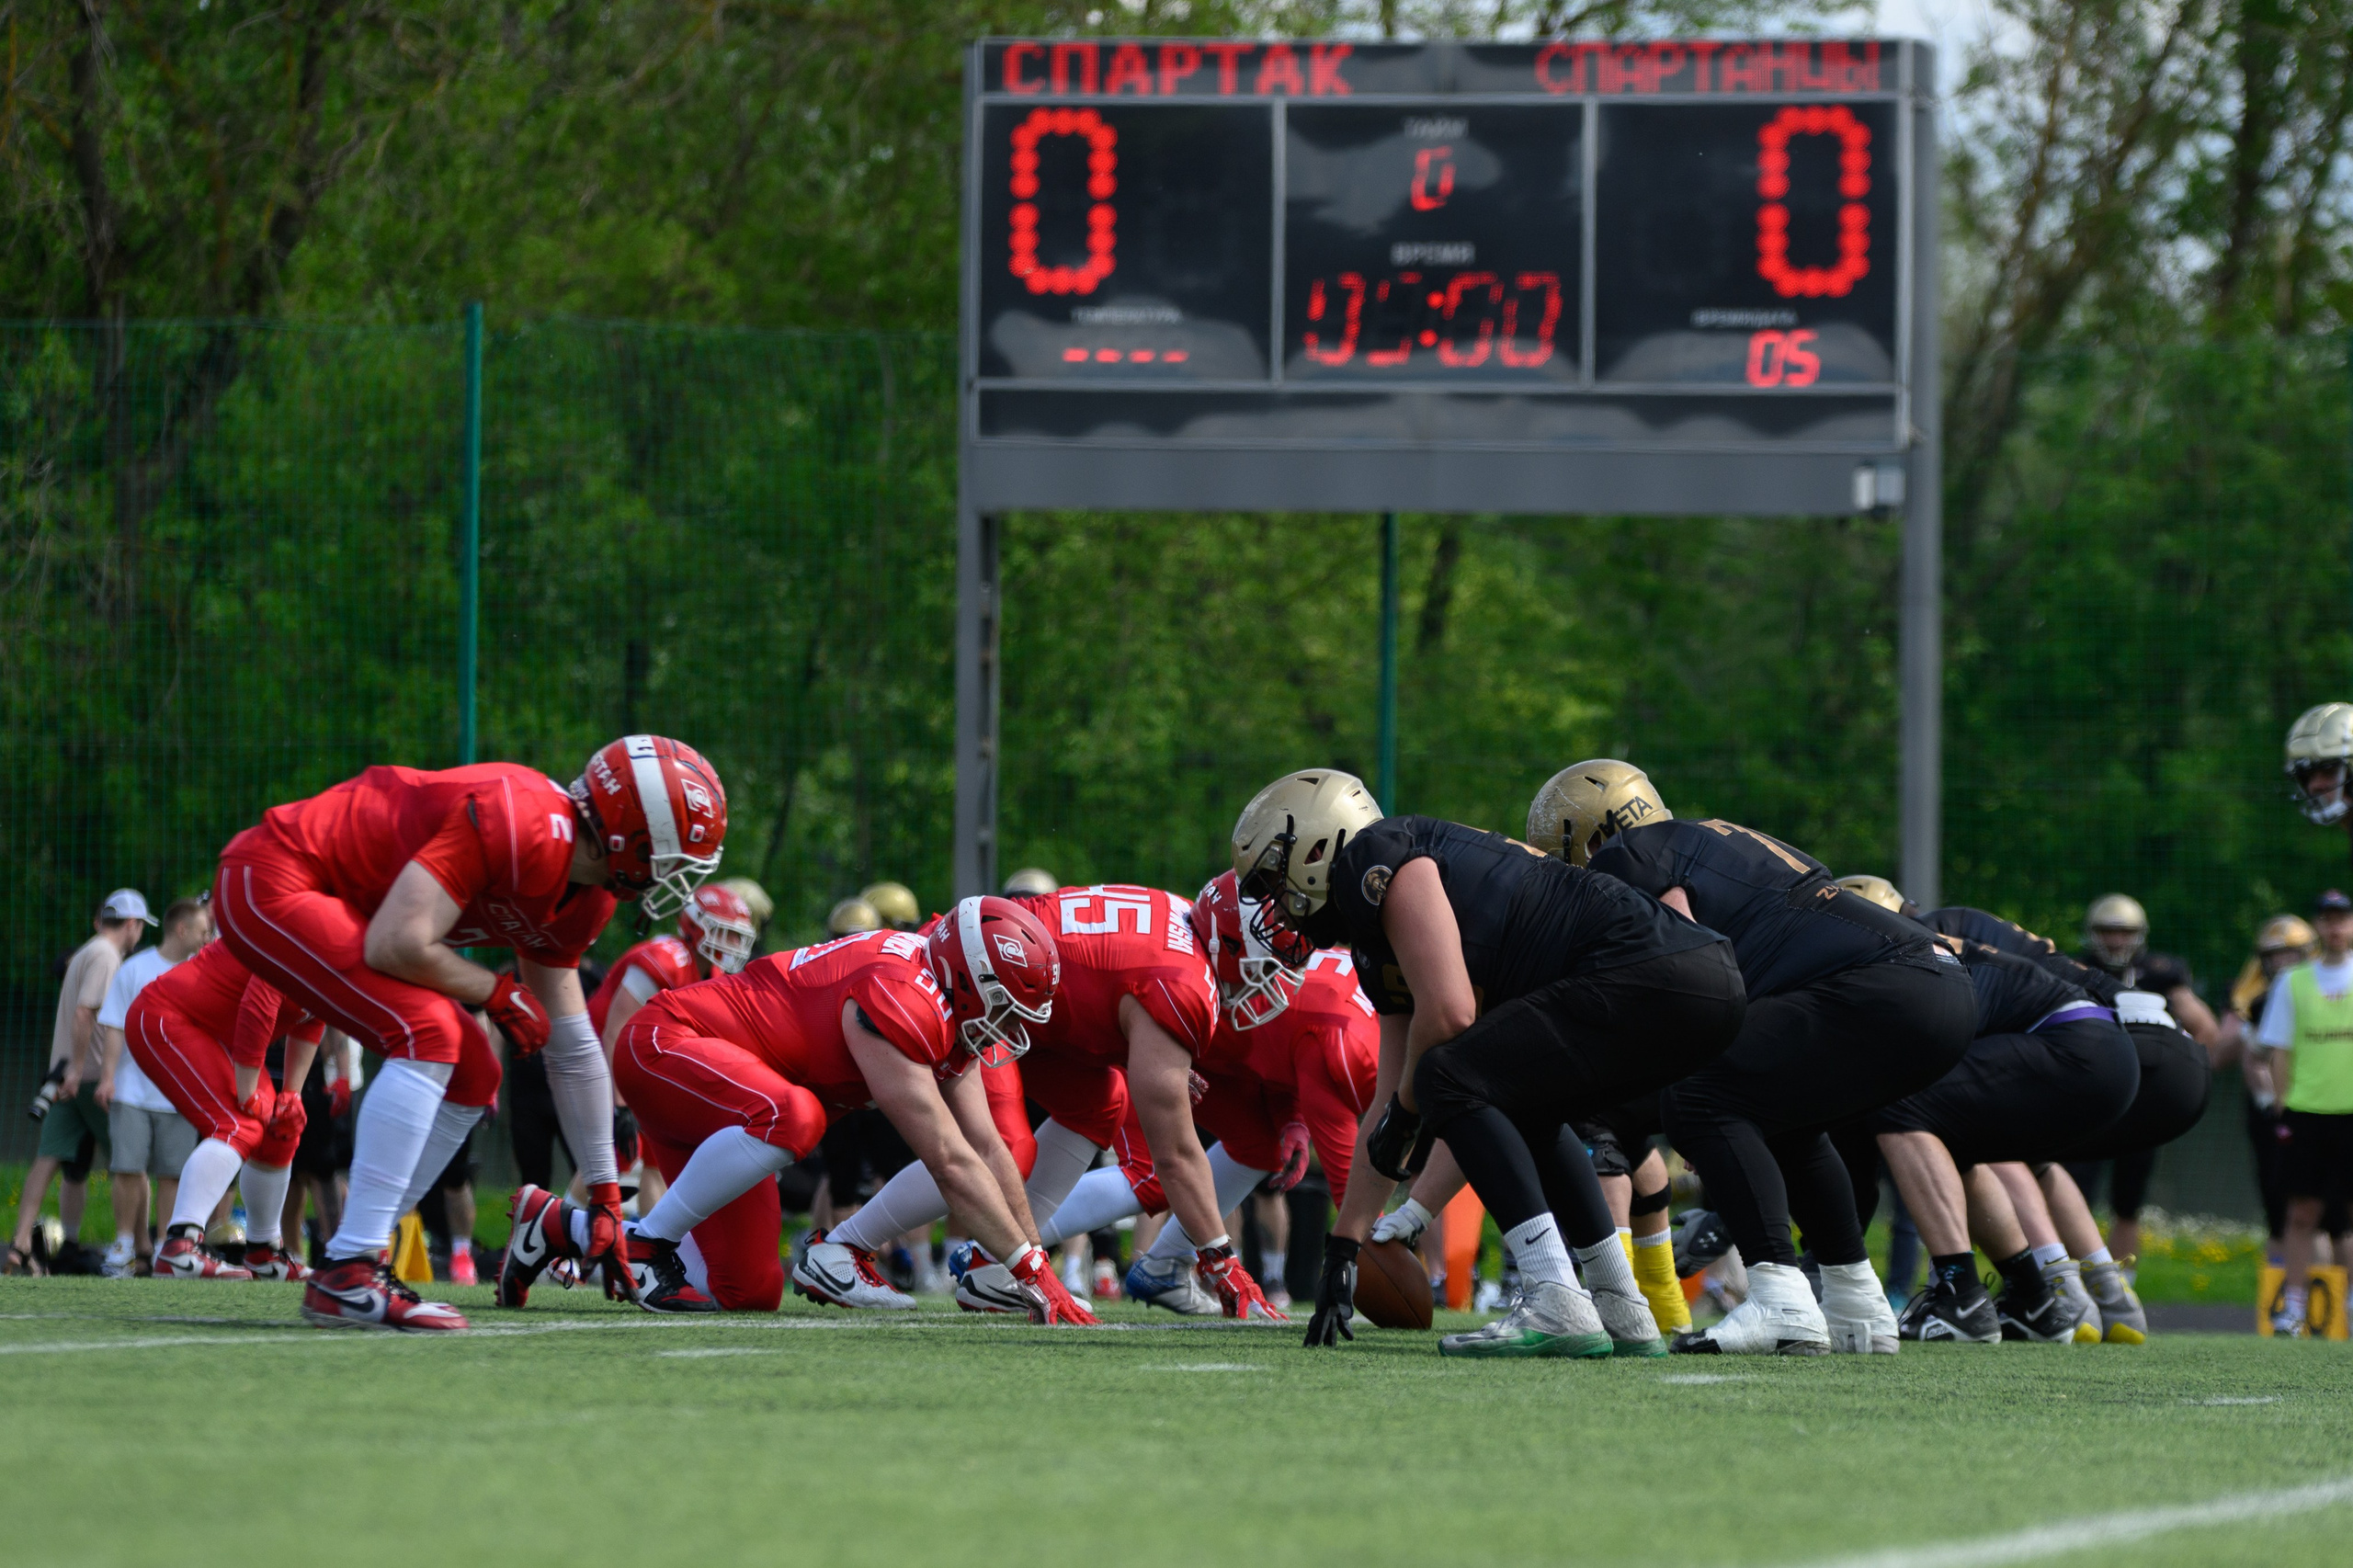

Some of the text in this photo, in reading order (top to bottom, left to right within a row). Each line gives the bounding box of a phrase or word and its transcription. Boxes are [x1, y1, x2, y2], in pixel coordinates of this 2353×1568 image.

[1002, 41, 1354, 95] СПАРТАК
[1009, 107, 1118, 295] 0
[1756, 105, 1871, 297] 0
[1746, 327, 1822, 388] 05
